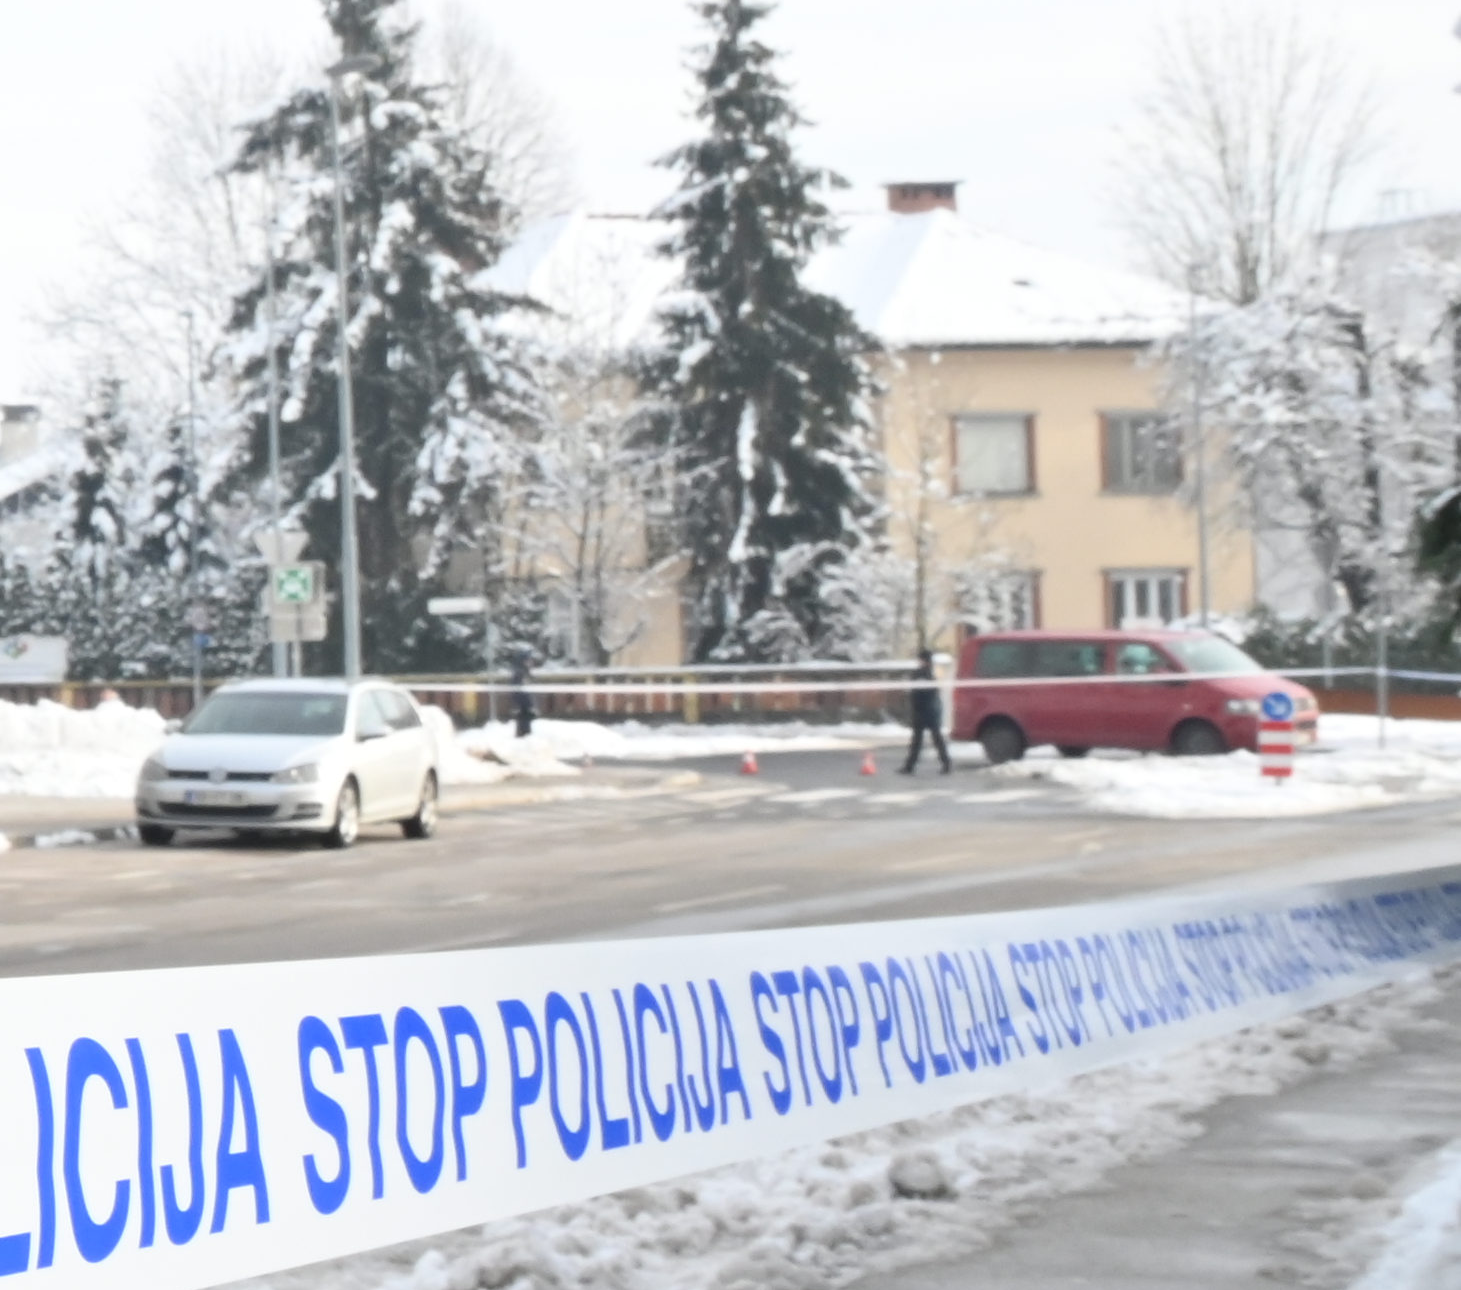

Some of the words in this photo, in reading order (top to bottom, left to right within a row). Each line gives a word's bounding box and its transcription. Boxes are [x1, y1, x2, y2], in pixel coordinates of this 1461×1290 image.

[297, 1004, 489, 1216] STOP
[497, 977, 753, 1170] POLICIJA
[749, 964, 862, 1117] STOP
[858, 947, 1026, 1089] POLICIJA
[1007, 940, 1093, 1055] STOP
